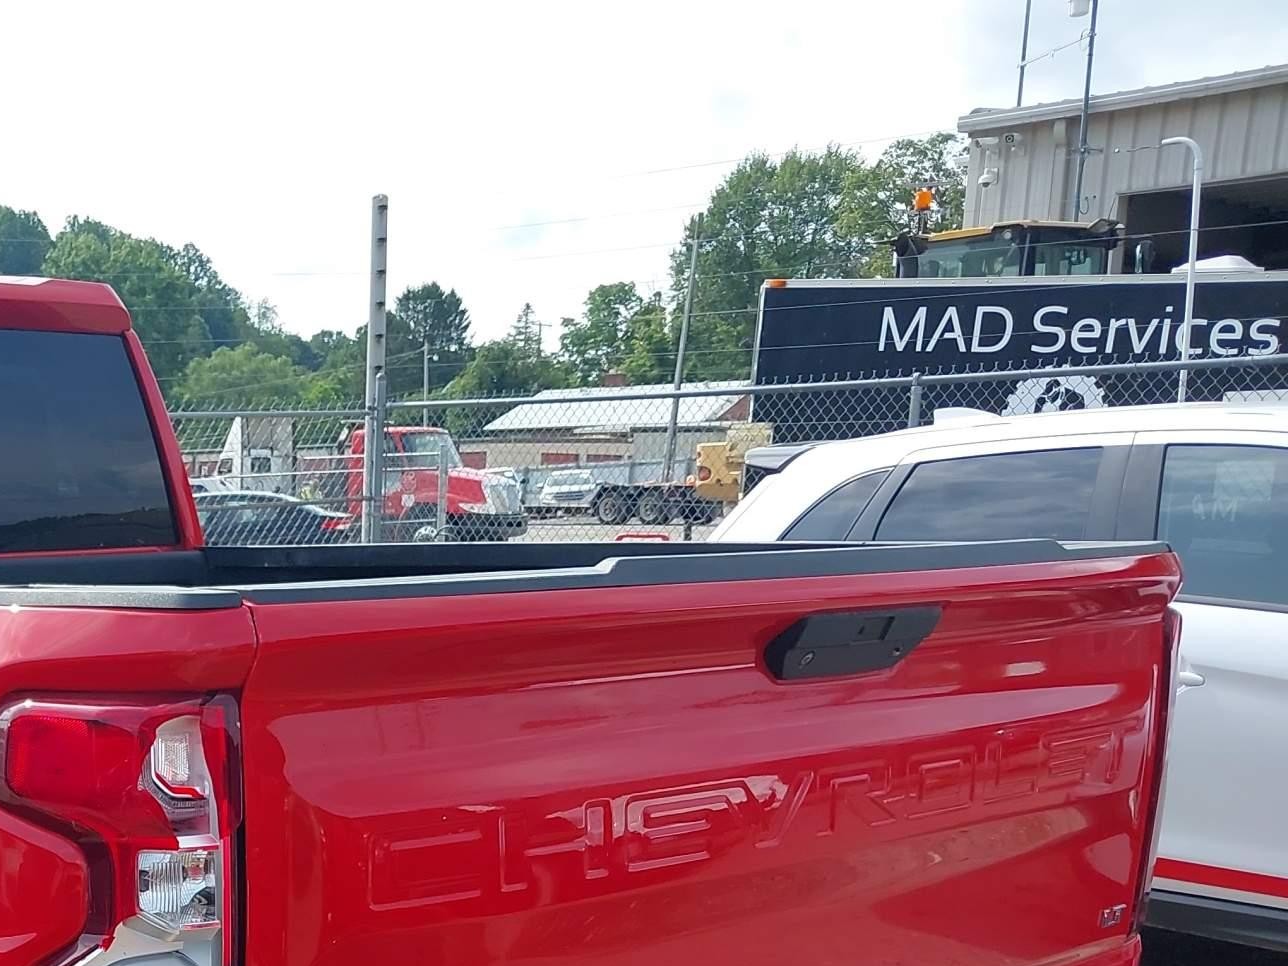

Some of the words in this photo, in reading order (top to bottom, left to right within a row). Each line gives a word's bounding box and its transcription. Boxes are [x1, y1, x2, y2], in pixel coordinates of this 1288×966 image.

[878, 305, 1014, 353] MAD
[1030, 305, 1282, 355] Services
[365, 715, 1146, 912] CHEVROLET
[1098, 903, 1128, 929] LT
